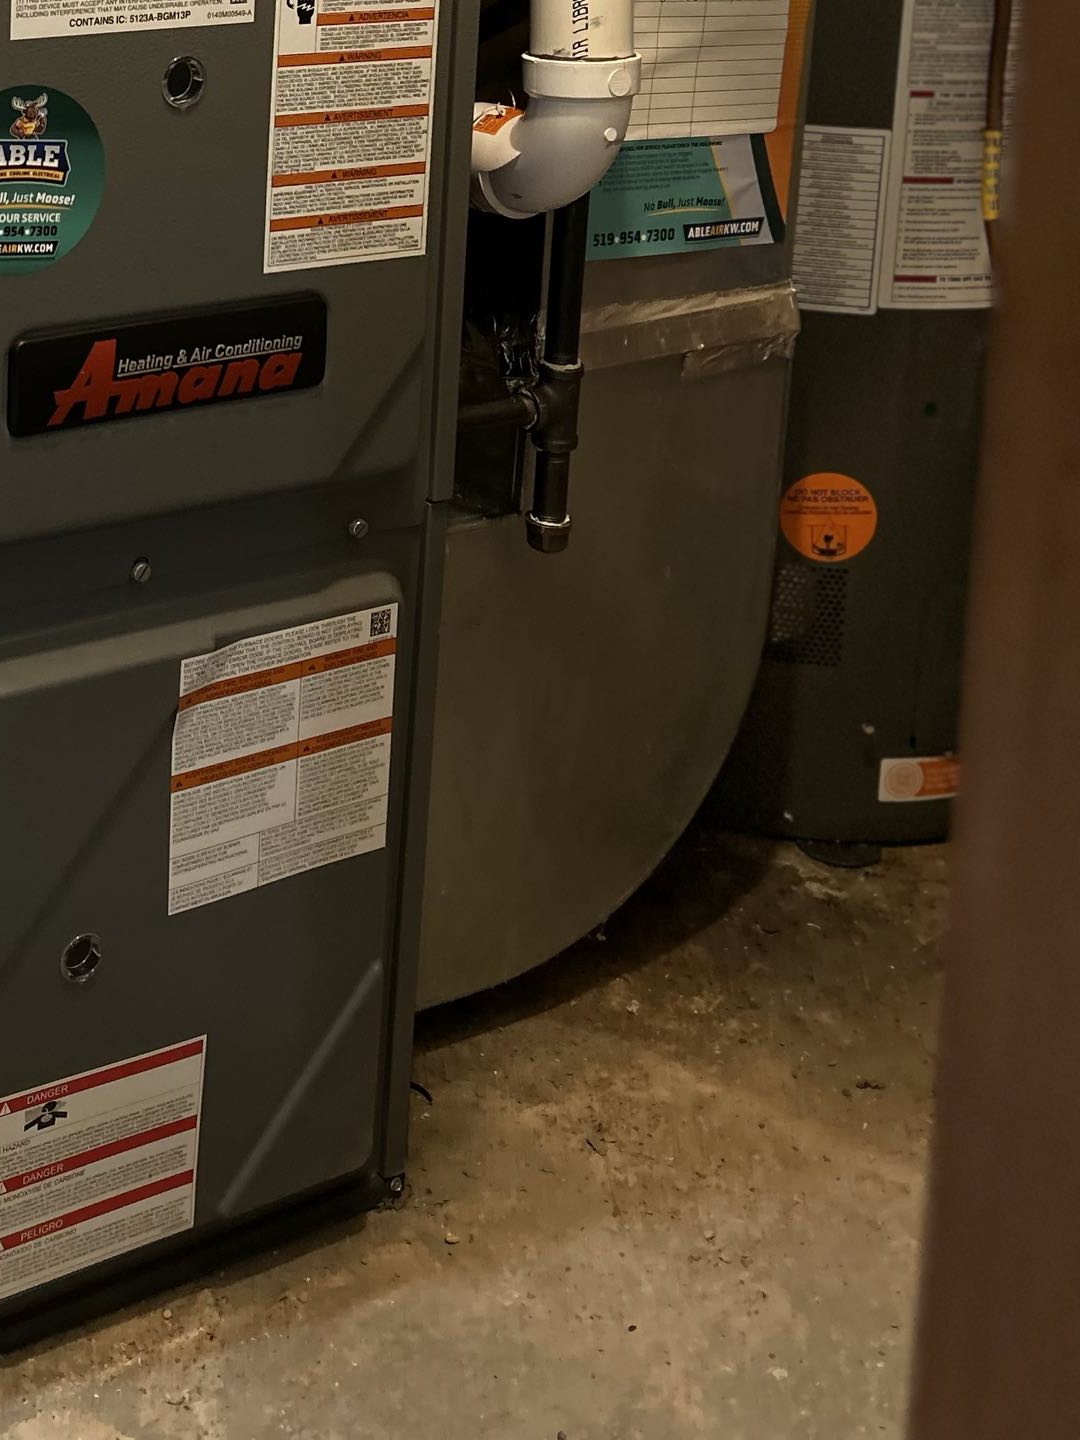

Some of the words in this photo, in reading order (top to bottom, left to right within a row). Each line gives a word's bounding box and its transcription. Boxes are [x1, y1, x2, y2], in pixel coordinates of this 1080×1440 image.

[69, 17, 114, 28] CONTAINS
[116, 16, 128, 24] IC:
[130, 11, 191, 23] 5123A-BGM13P
[357, 10, 410, 21] ADVERTENCIA
[346, 51, 382, 62] WARNING
[332, 109, 394, 122] AVERTISSEMENT
[341, 167, 378, 178] WARNING
[11, 192, 34, 204] Just
[36, 192, 75, 206] Moose!
[644, 202, 654, 212] No
[657, 198, 676, 210] Bull,
[677, 198, 694, 208] Just
[22, 212, 61, 222] SERVICE
[328, 210, 389, 224] AVERTISSEMENT
[688, 221, 759, 238] ABLEAIRKW.COM
[118, 353, 173, 373] Heating
[177, 349, 187, 365] &
[191, 345, 212, 362] Air
[214, 335, 303, 358] Conditioning
[47, 338, 303, 426] Amana
[26, 1084, 69, 1105] DANGER
[22, 1163, 65, 1185] DANGER
[20, 1219, 64, 1242] PELIGRO
